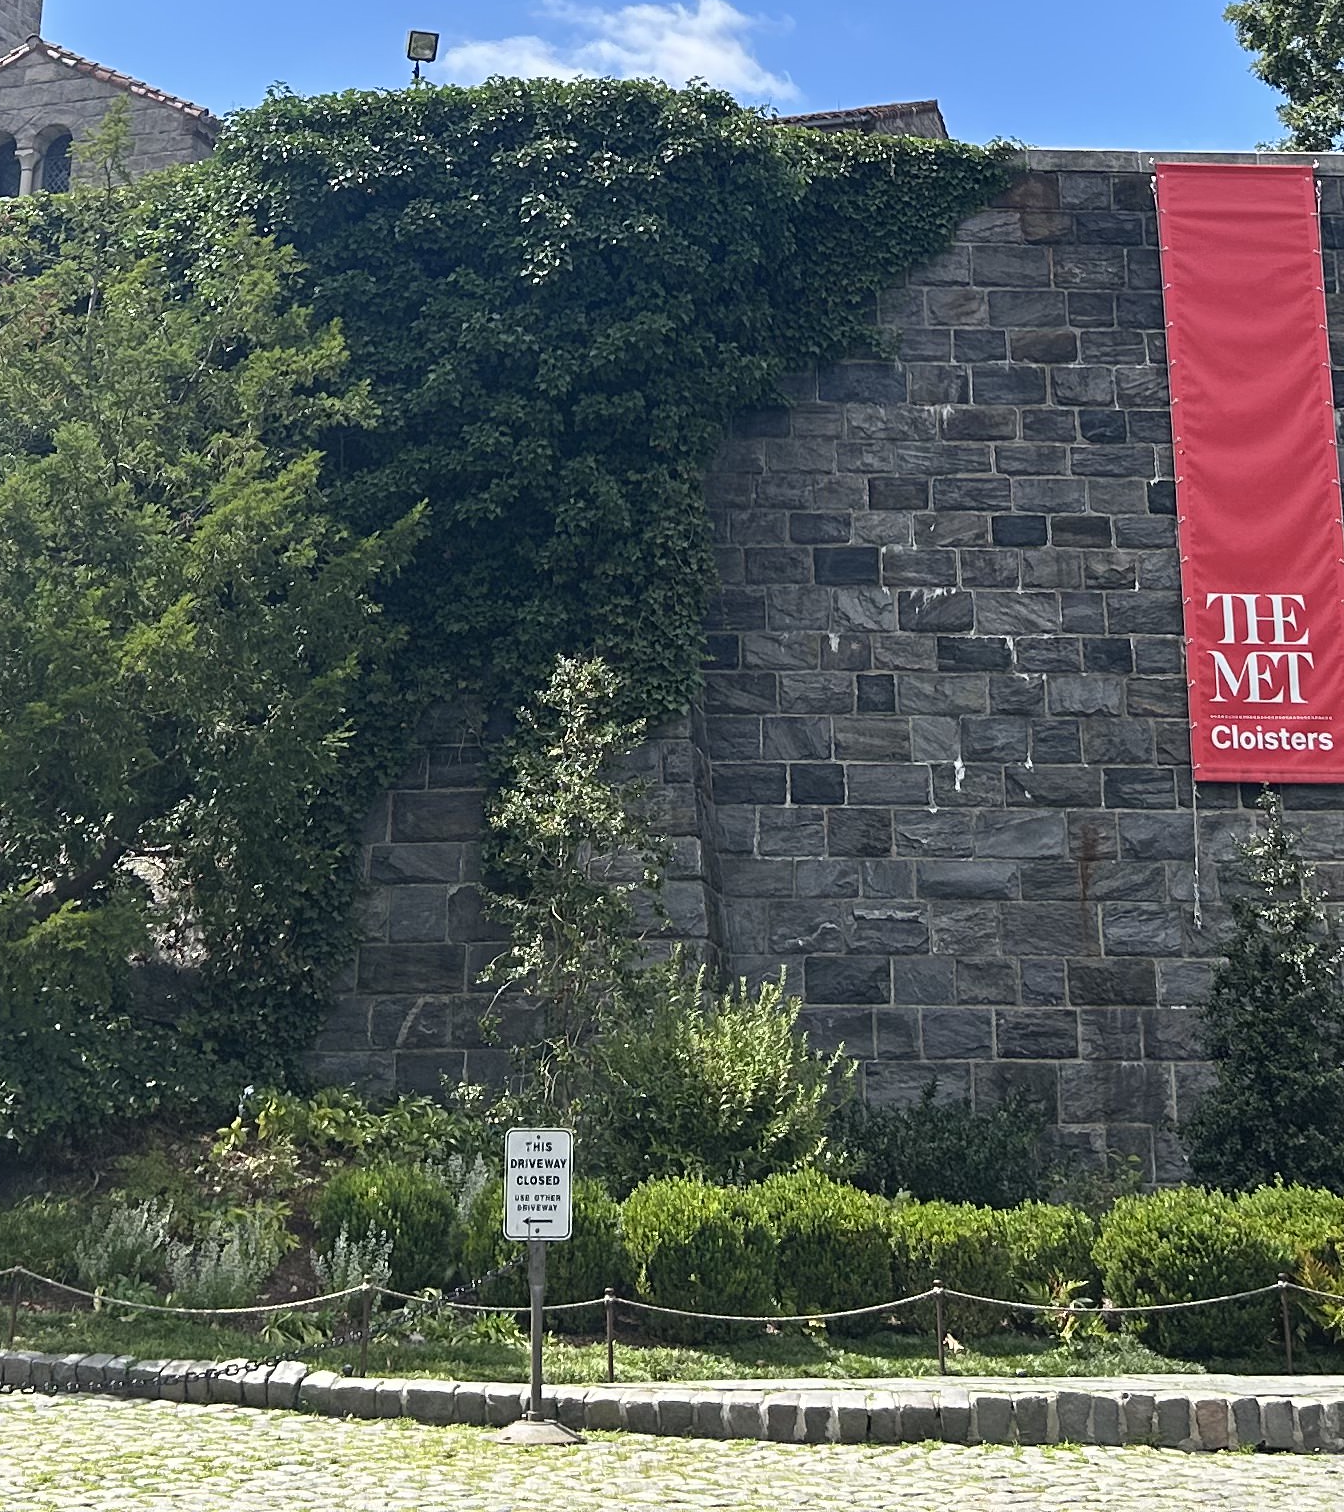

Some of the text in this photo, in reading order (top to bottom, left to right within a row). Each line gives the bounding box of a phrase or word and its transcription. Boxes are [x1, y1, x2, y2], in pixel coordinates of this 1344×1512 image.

[1206, 592, 1310, 645] THE
[1206, 650, 1315, 704] MET
[1211, 724, 1334, 751] Cloisters
[525, 1141, 553, 1152] THIS
[510, 1158, 567, 1169] DRIVEWAY
[516, 1175, 560, 1186] CLOSED
[514, 1194, 561, 1202] USE OTHER
[517, 1204, 558, 1212] DRIVEWAY
